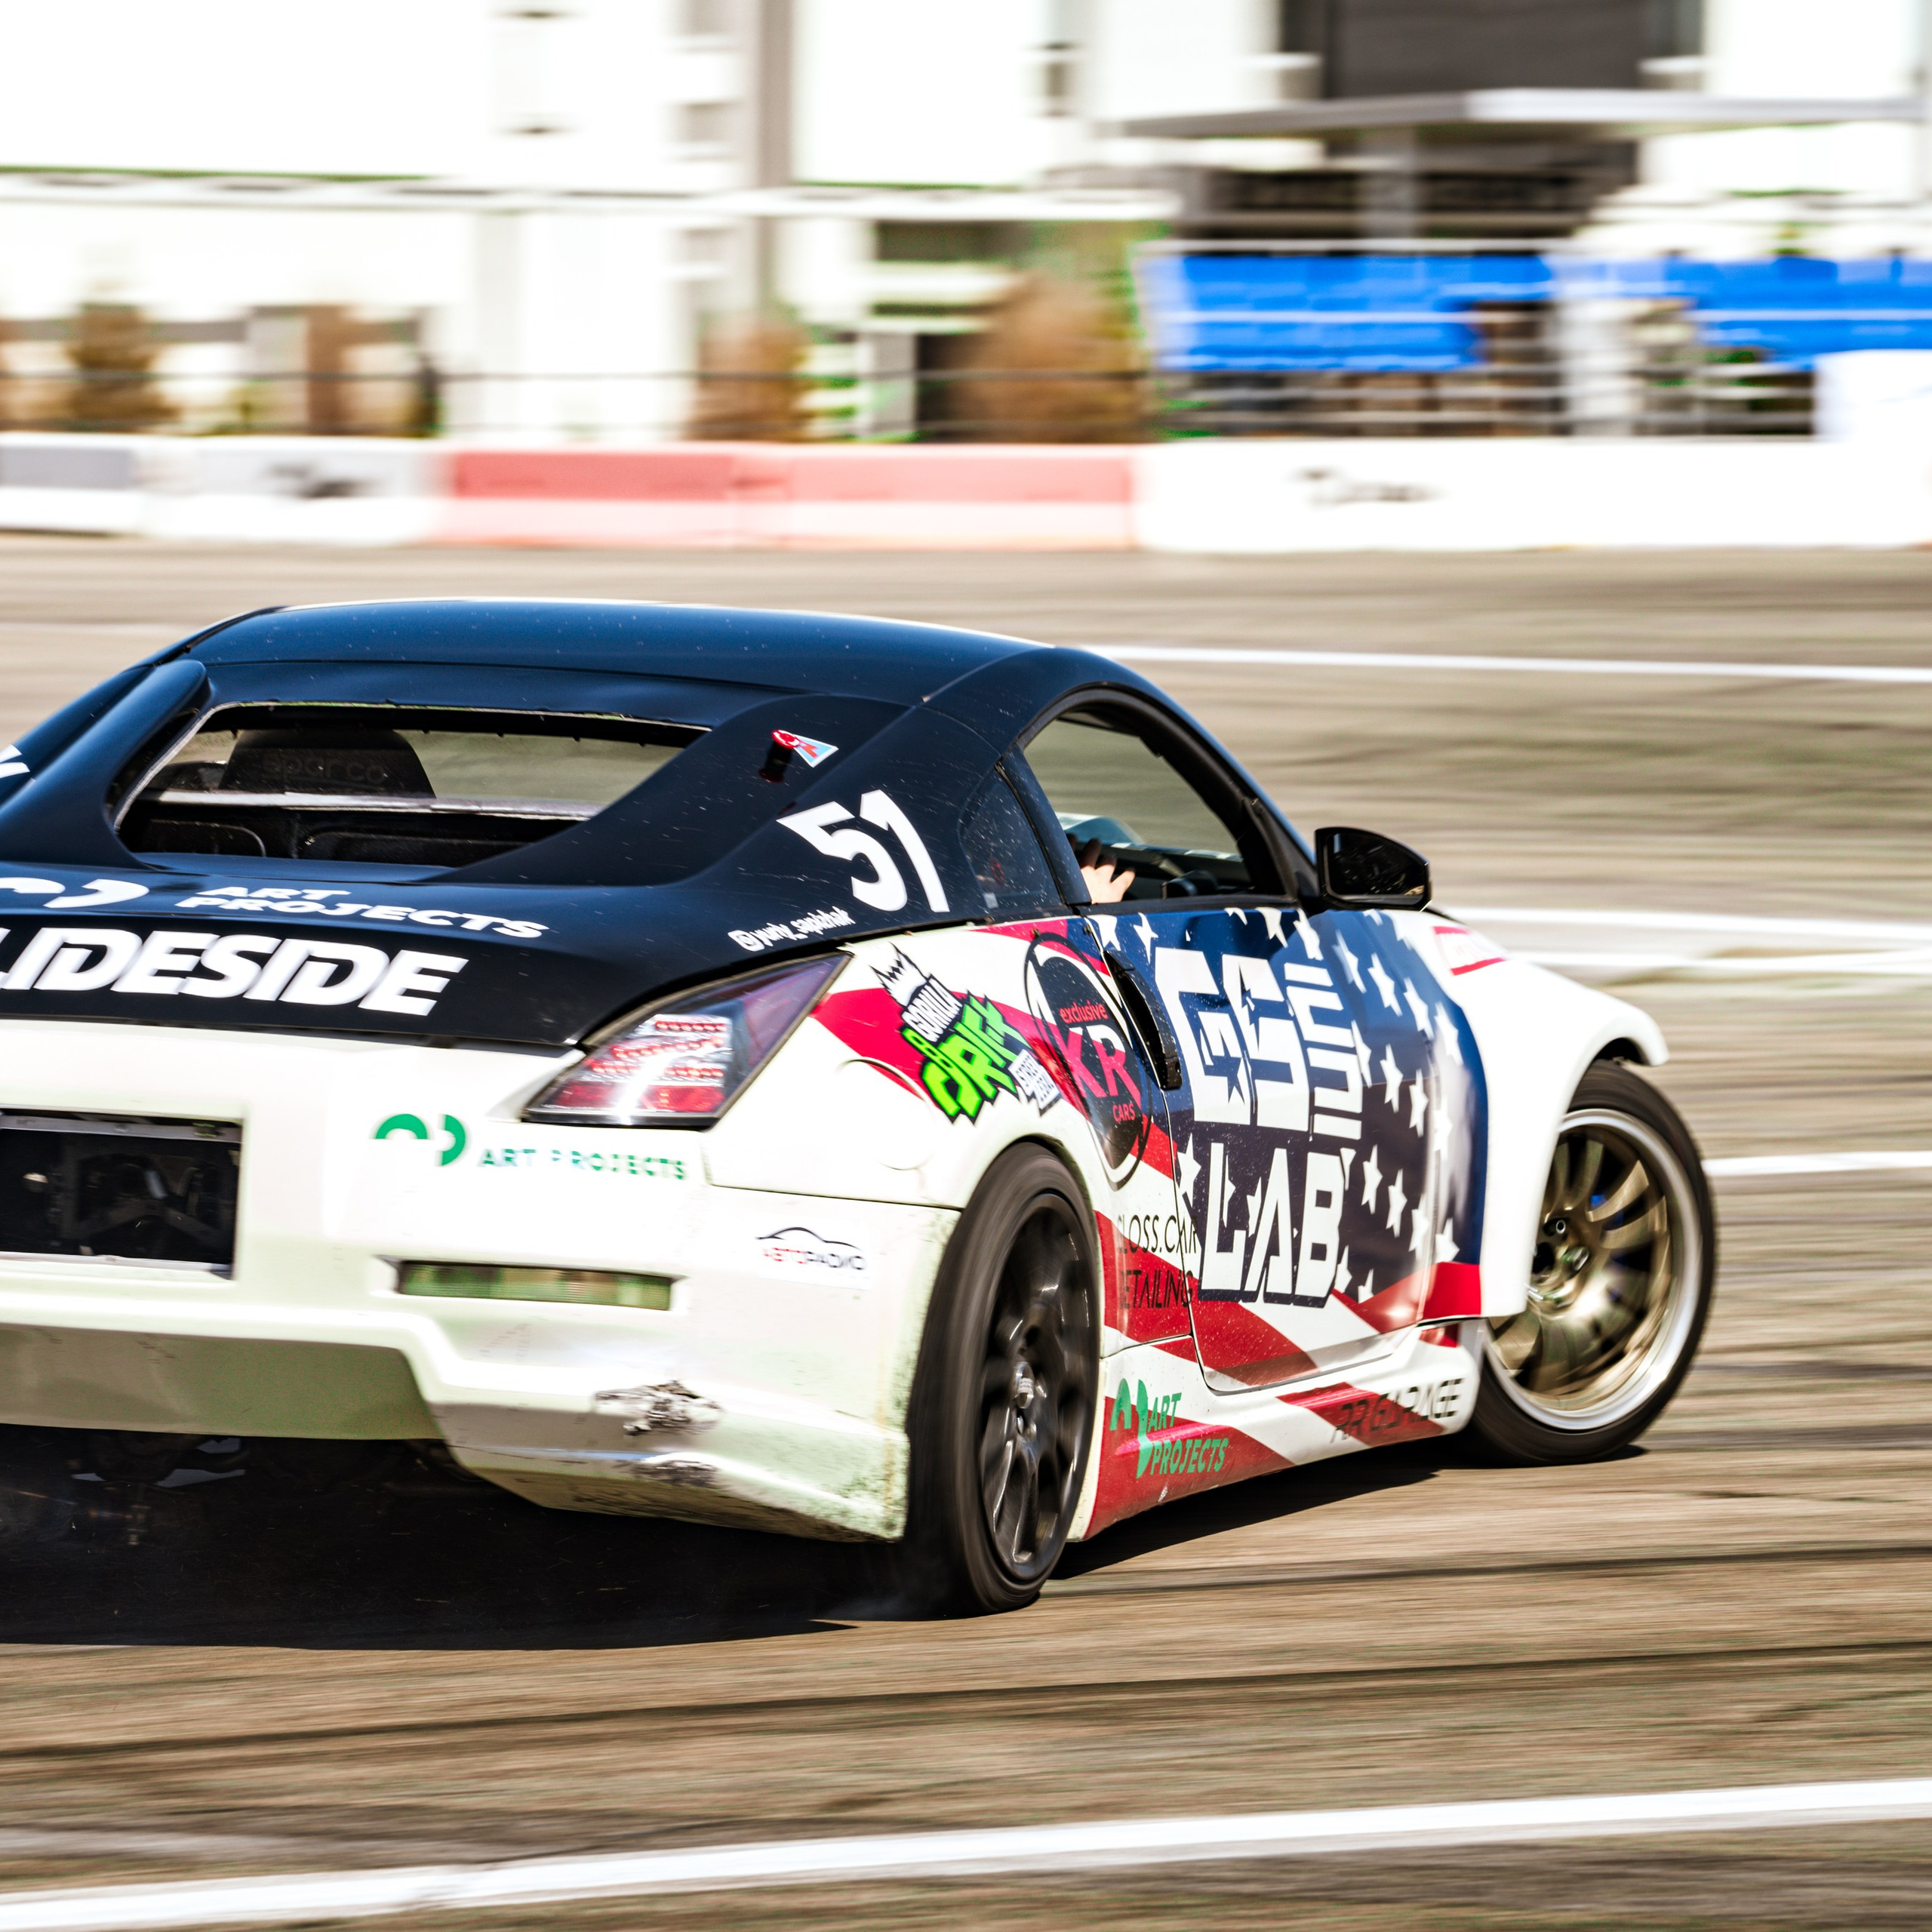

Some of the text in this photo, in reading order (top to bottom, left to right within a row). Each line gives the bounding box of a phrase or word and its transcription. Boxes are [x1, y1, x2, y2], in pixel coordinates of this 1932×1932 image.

[776, 789, 950, 912] 51
[195, 886, 352, 900] ART
[174, 896, 550, 938] PROJECTS
[0, 927, 469, 1017] IDESIDE
[901, 977, 963, 1043] GORILLA
[1059, 999, 1109, 1024] exclusive
[902, 995, 1030, 1118] DRIFT
[1112, 1102, 1136, 1122] CARS
[478, 1148, 687, 1181] ART PROJECTS
[1200, 1142, 1346, 1300] LAB
[1147, 1392, 1183, 1433] ART
[1149, 1437, 1229, 1476] PROJECTS
